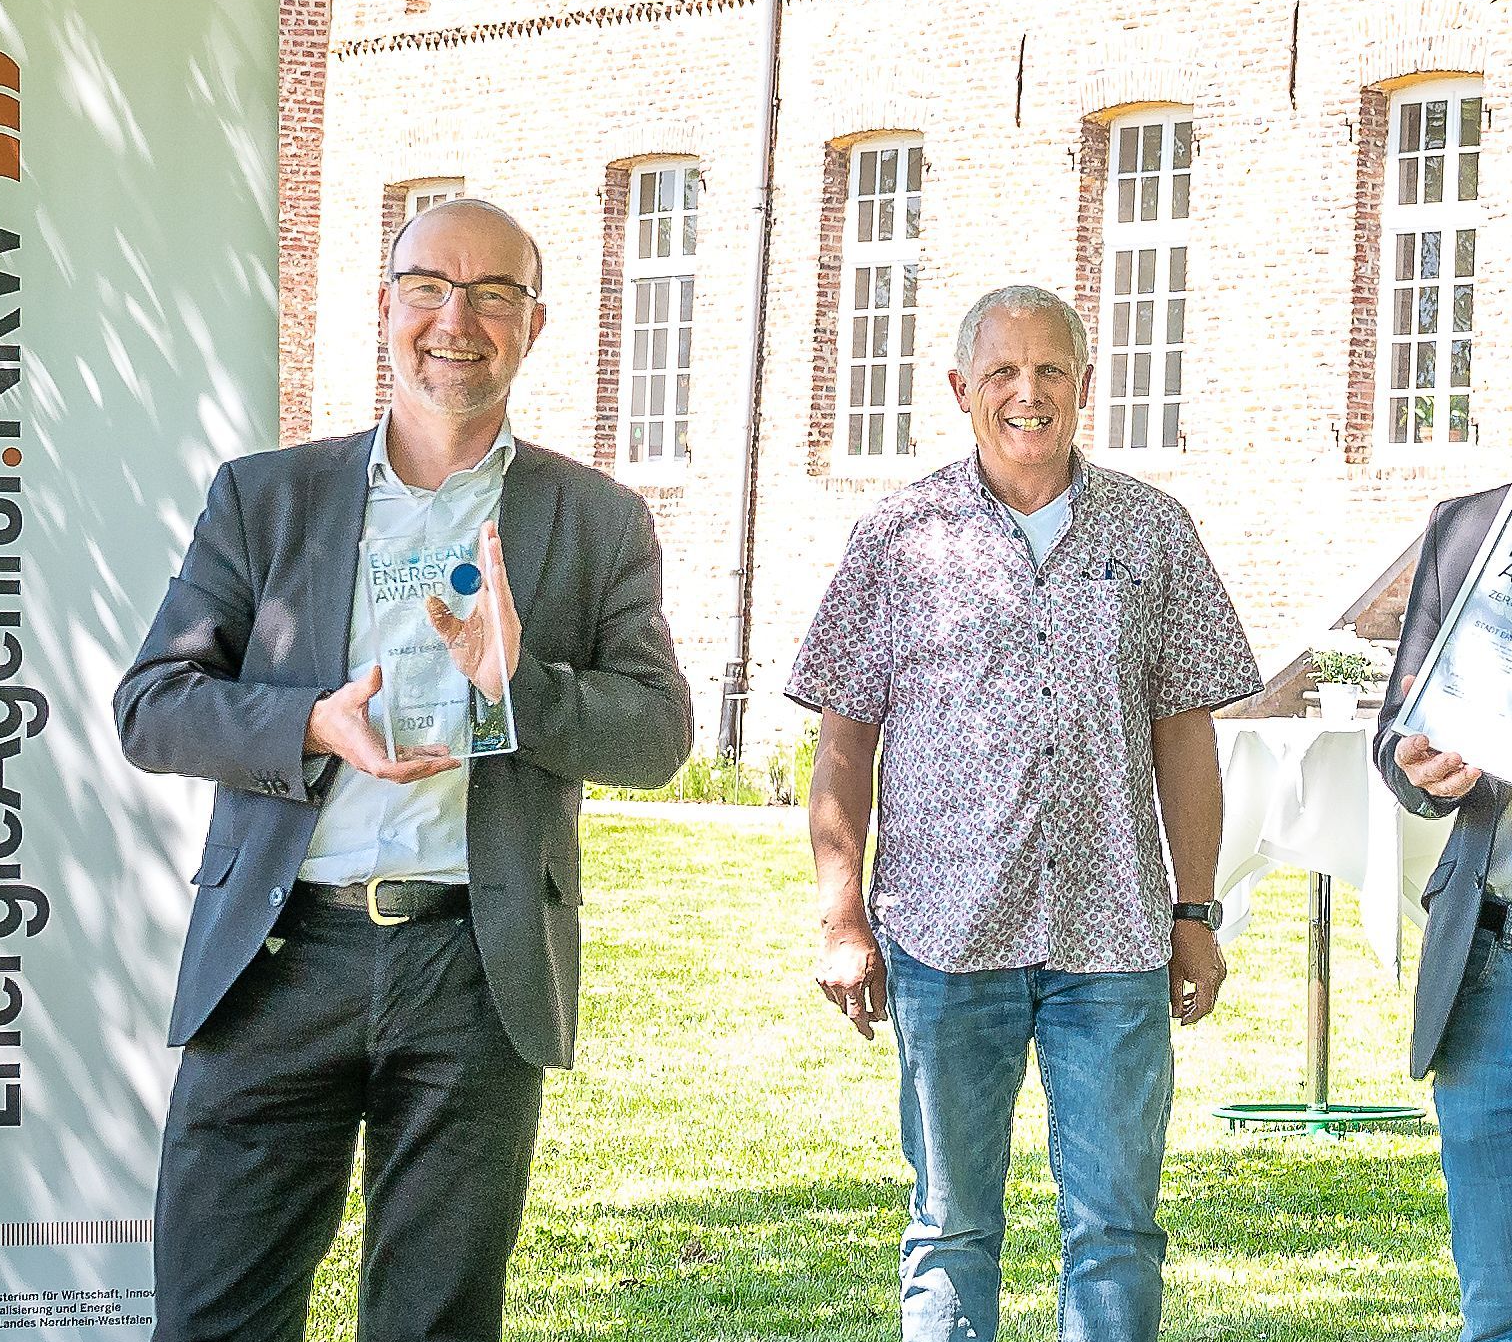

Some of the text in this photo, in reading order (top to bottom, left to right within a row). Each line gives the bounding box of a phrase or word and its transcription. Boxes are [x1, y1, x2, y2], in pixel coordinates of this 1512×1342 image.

[373, 563, 448, 586] ENERGY
[398, 715, 434, 732] 2020
[42, 1290, 58, 1301] für
[61, 1288, 122, 1300] Wirtschaft,
[55, 1303, 77, 1313] und
[79, 1302, 121, 1314] Energie
[39, 1314, 153, 1328] Nordrhein-Westfalen
